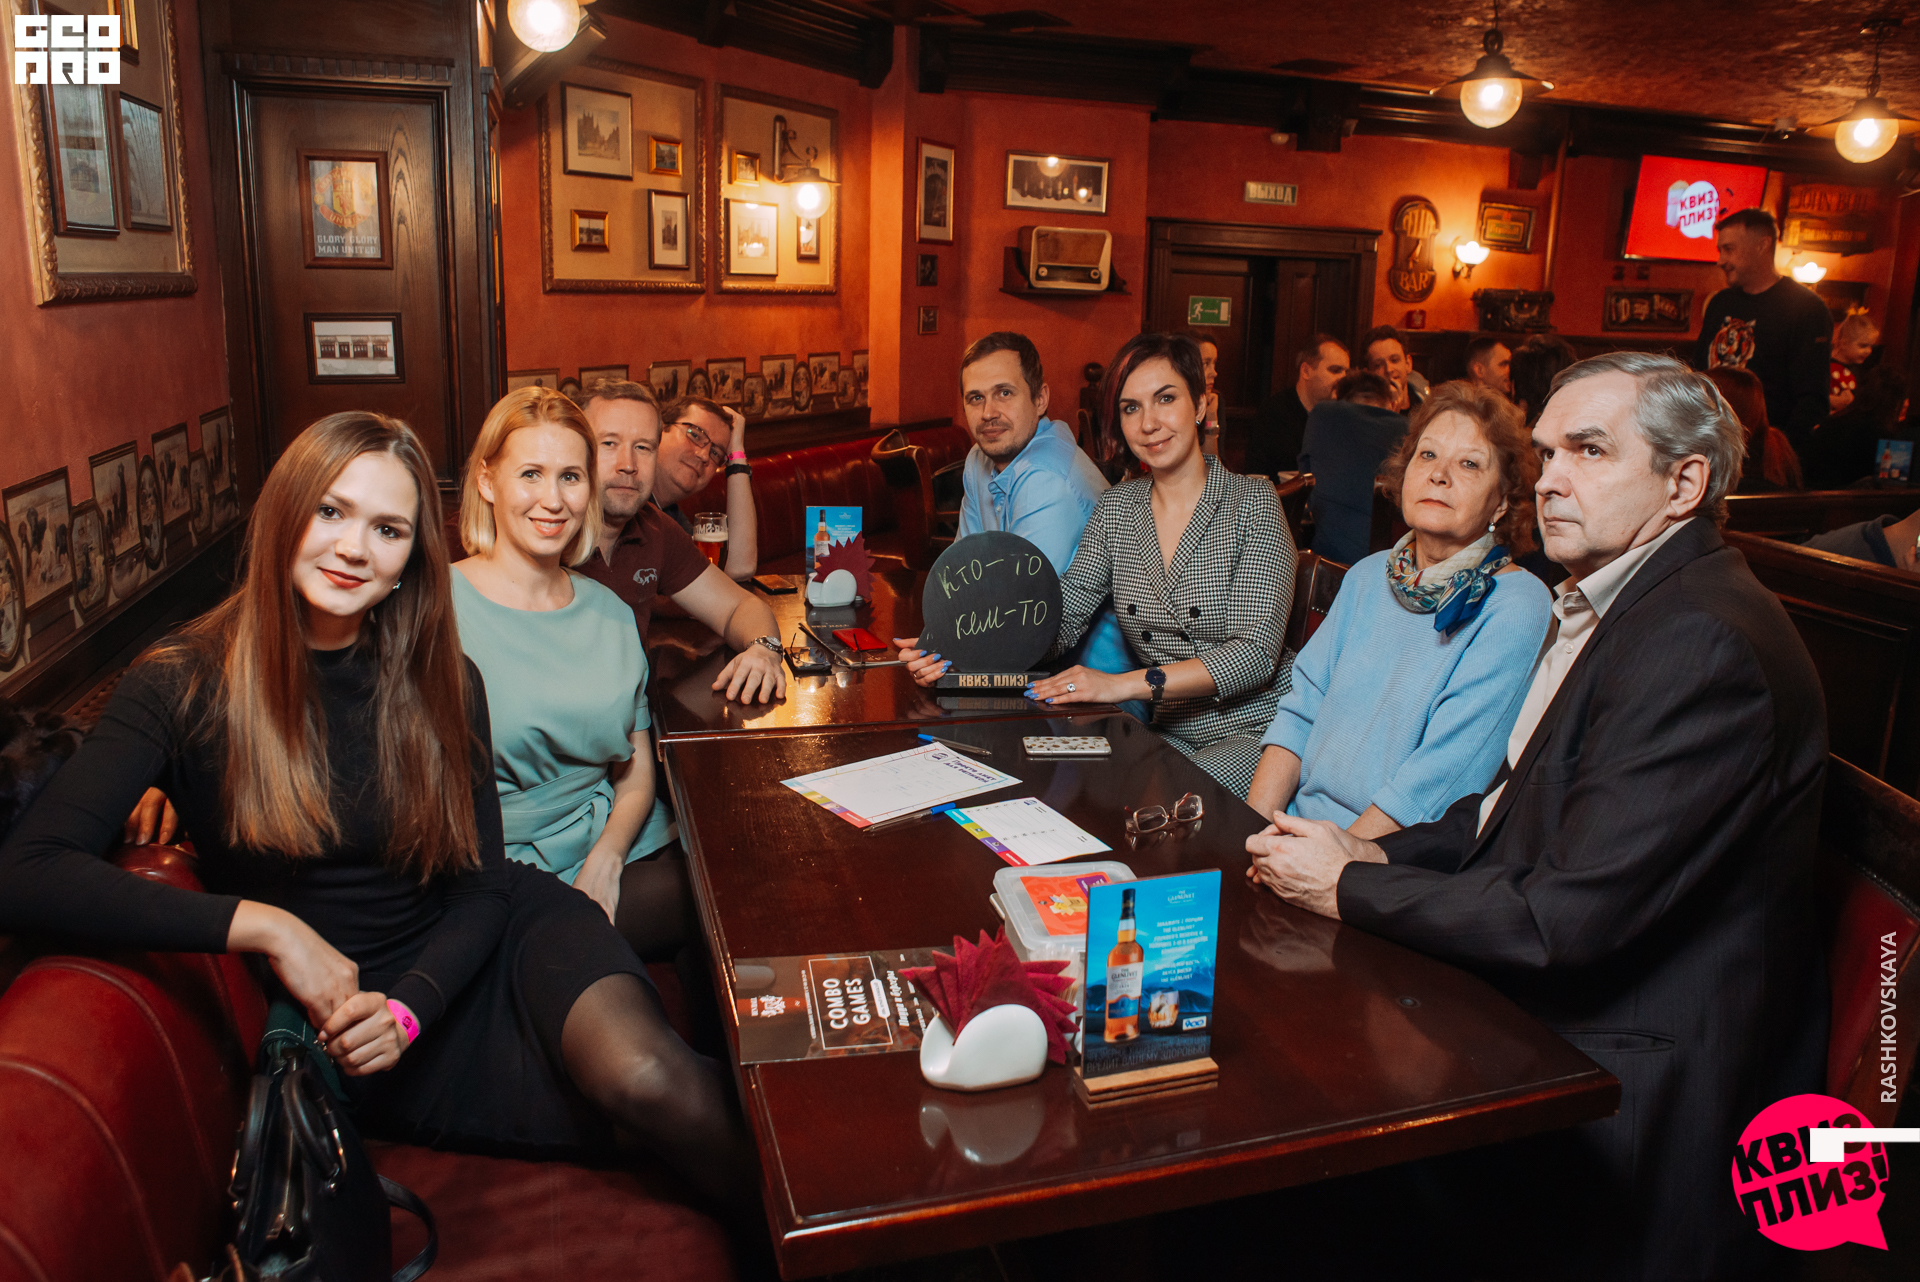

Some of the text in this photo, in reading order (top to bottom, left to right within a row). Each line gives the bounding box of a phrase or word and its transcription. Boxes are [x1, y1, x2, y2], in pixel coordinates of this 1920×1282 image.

[1249, 183, 1293, 204] ВЫХОД
[317, 234, 378, 244] GLORY GLORY
[318, 245, 376, 255] MAN UNITED
[1400, 272, 1429, 291] BAR
[959, 674, 1028, 688] КВИЗ, ПЛИЗ!
[822, 978, 849, 1030] COMBO
[844, 978, 871, 1026] GAMES
